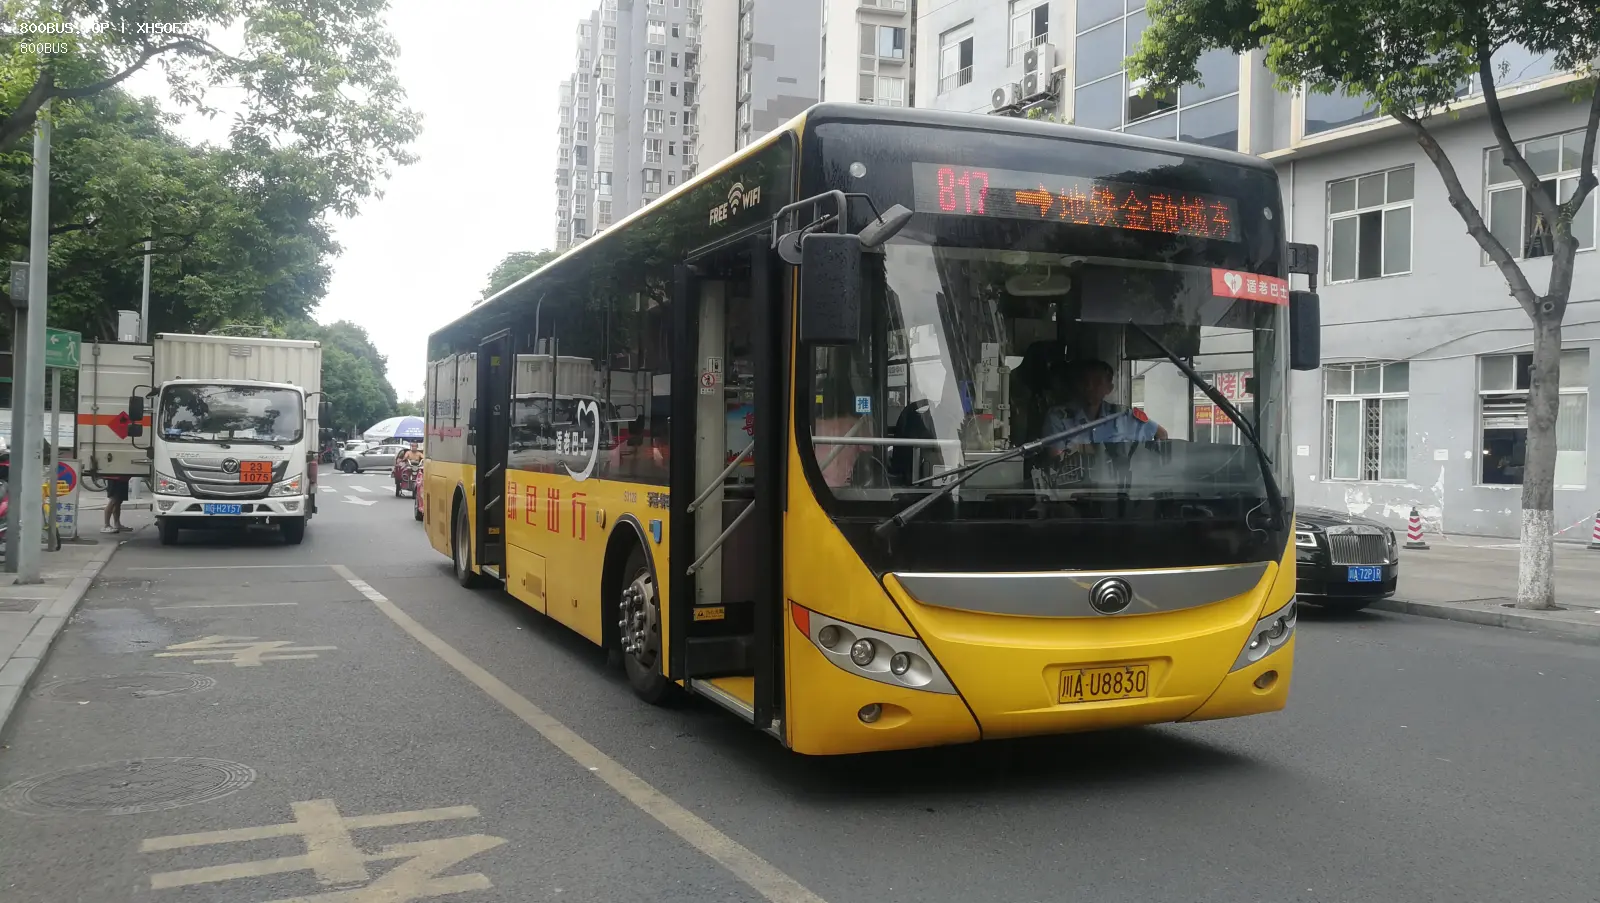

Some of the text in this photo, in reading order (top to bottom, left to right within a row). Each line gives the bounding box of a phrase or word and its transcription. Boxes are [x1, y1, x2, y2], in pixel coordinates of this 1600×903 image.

[937, 167, 989, 215] 817
[709, 185, 761, 226] FREE WIFI
[1058, 183, 1231, 239] 地铁金融城东
[1246, 278, 1288, 299] 适老巴士
[857, 397, 869, 410] 推
[555, 430, 588, 457] 适老巴士
[243, 473, 269, 482] 1075
[250, 462, 263, 472] 23
[507, 480, 587, 542] 绿色出行
